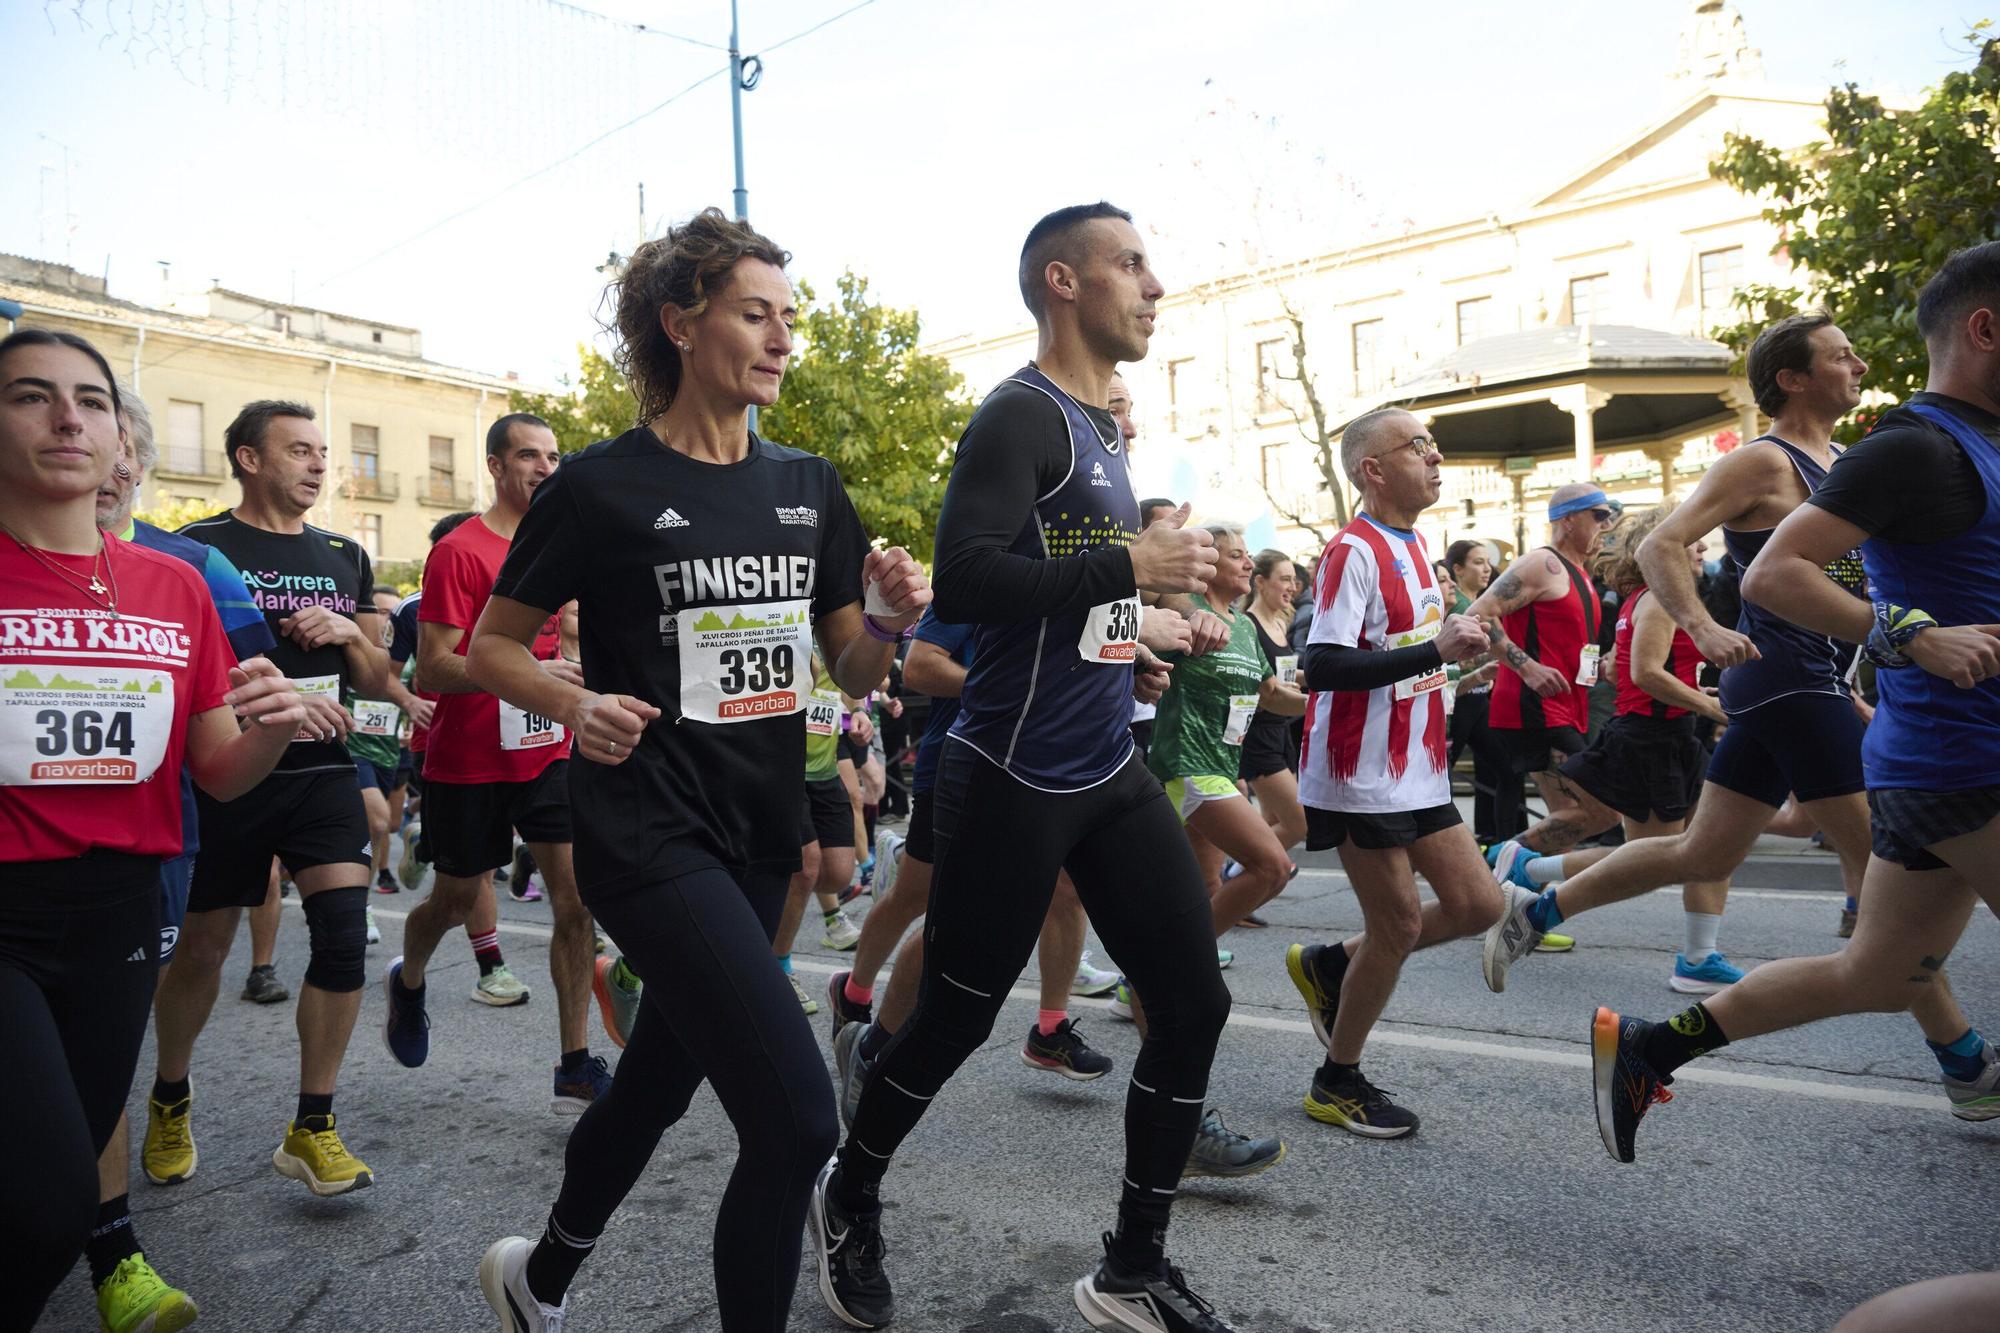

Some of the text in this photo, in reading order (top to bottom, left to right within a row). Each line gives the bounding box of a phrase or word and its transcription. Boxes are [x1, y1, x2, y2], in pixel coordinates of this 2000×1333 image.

[654, 520, 690, 529] adidas
[1107, 602, 1137, 641] 338
[744, 629, 765, 637] PEÑAS
[776, 626, 798, 634] TAFALLA
[695, 640, 740, 648] TAFALLAKO
[741, 638, 762, 646] PEÑEN
[1103, 645, 1136, 657] navarba
[720, 644, 794, 695] 339
[1415, 674, 1446, 691] navarban
[65, 691, 93, 699] PEÑAS
[5, 699, 59, 707] TAFALLAKO
[61, 699, 92, 707] PEÑEN
[93, 700, 119, 708] HERRI
[724, 696, 794, 716] navarban
[366, 713, 388, 727] 251
[810, 706, 834, 724] 449
[36, 709, 135, 756] 364
[38, 762, 132, 777] navarban
